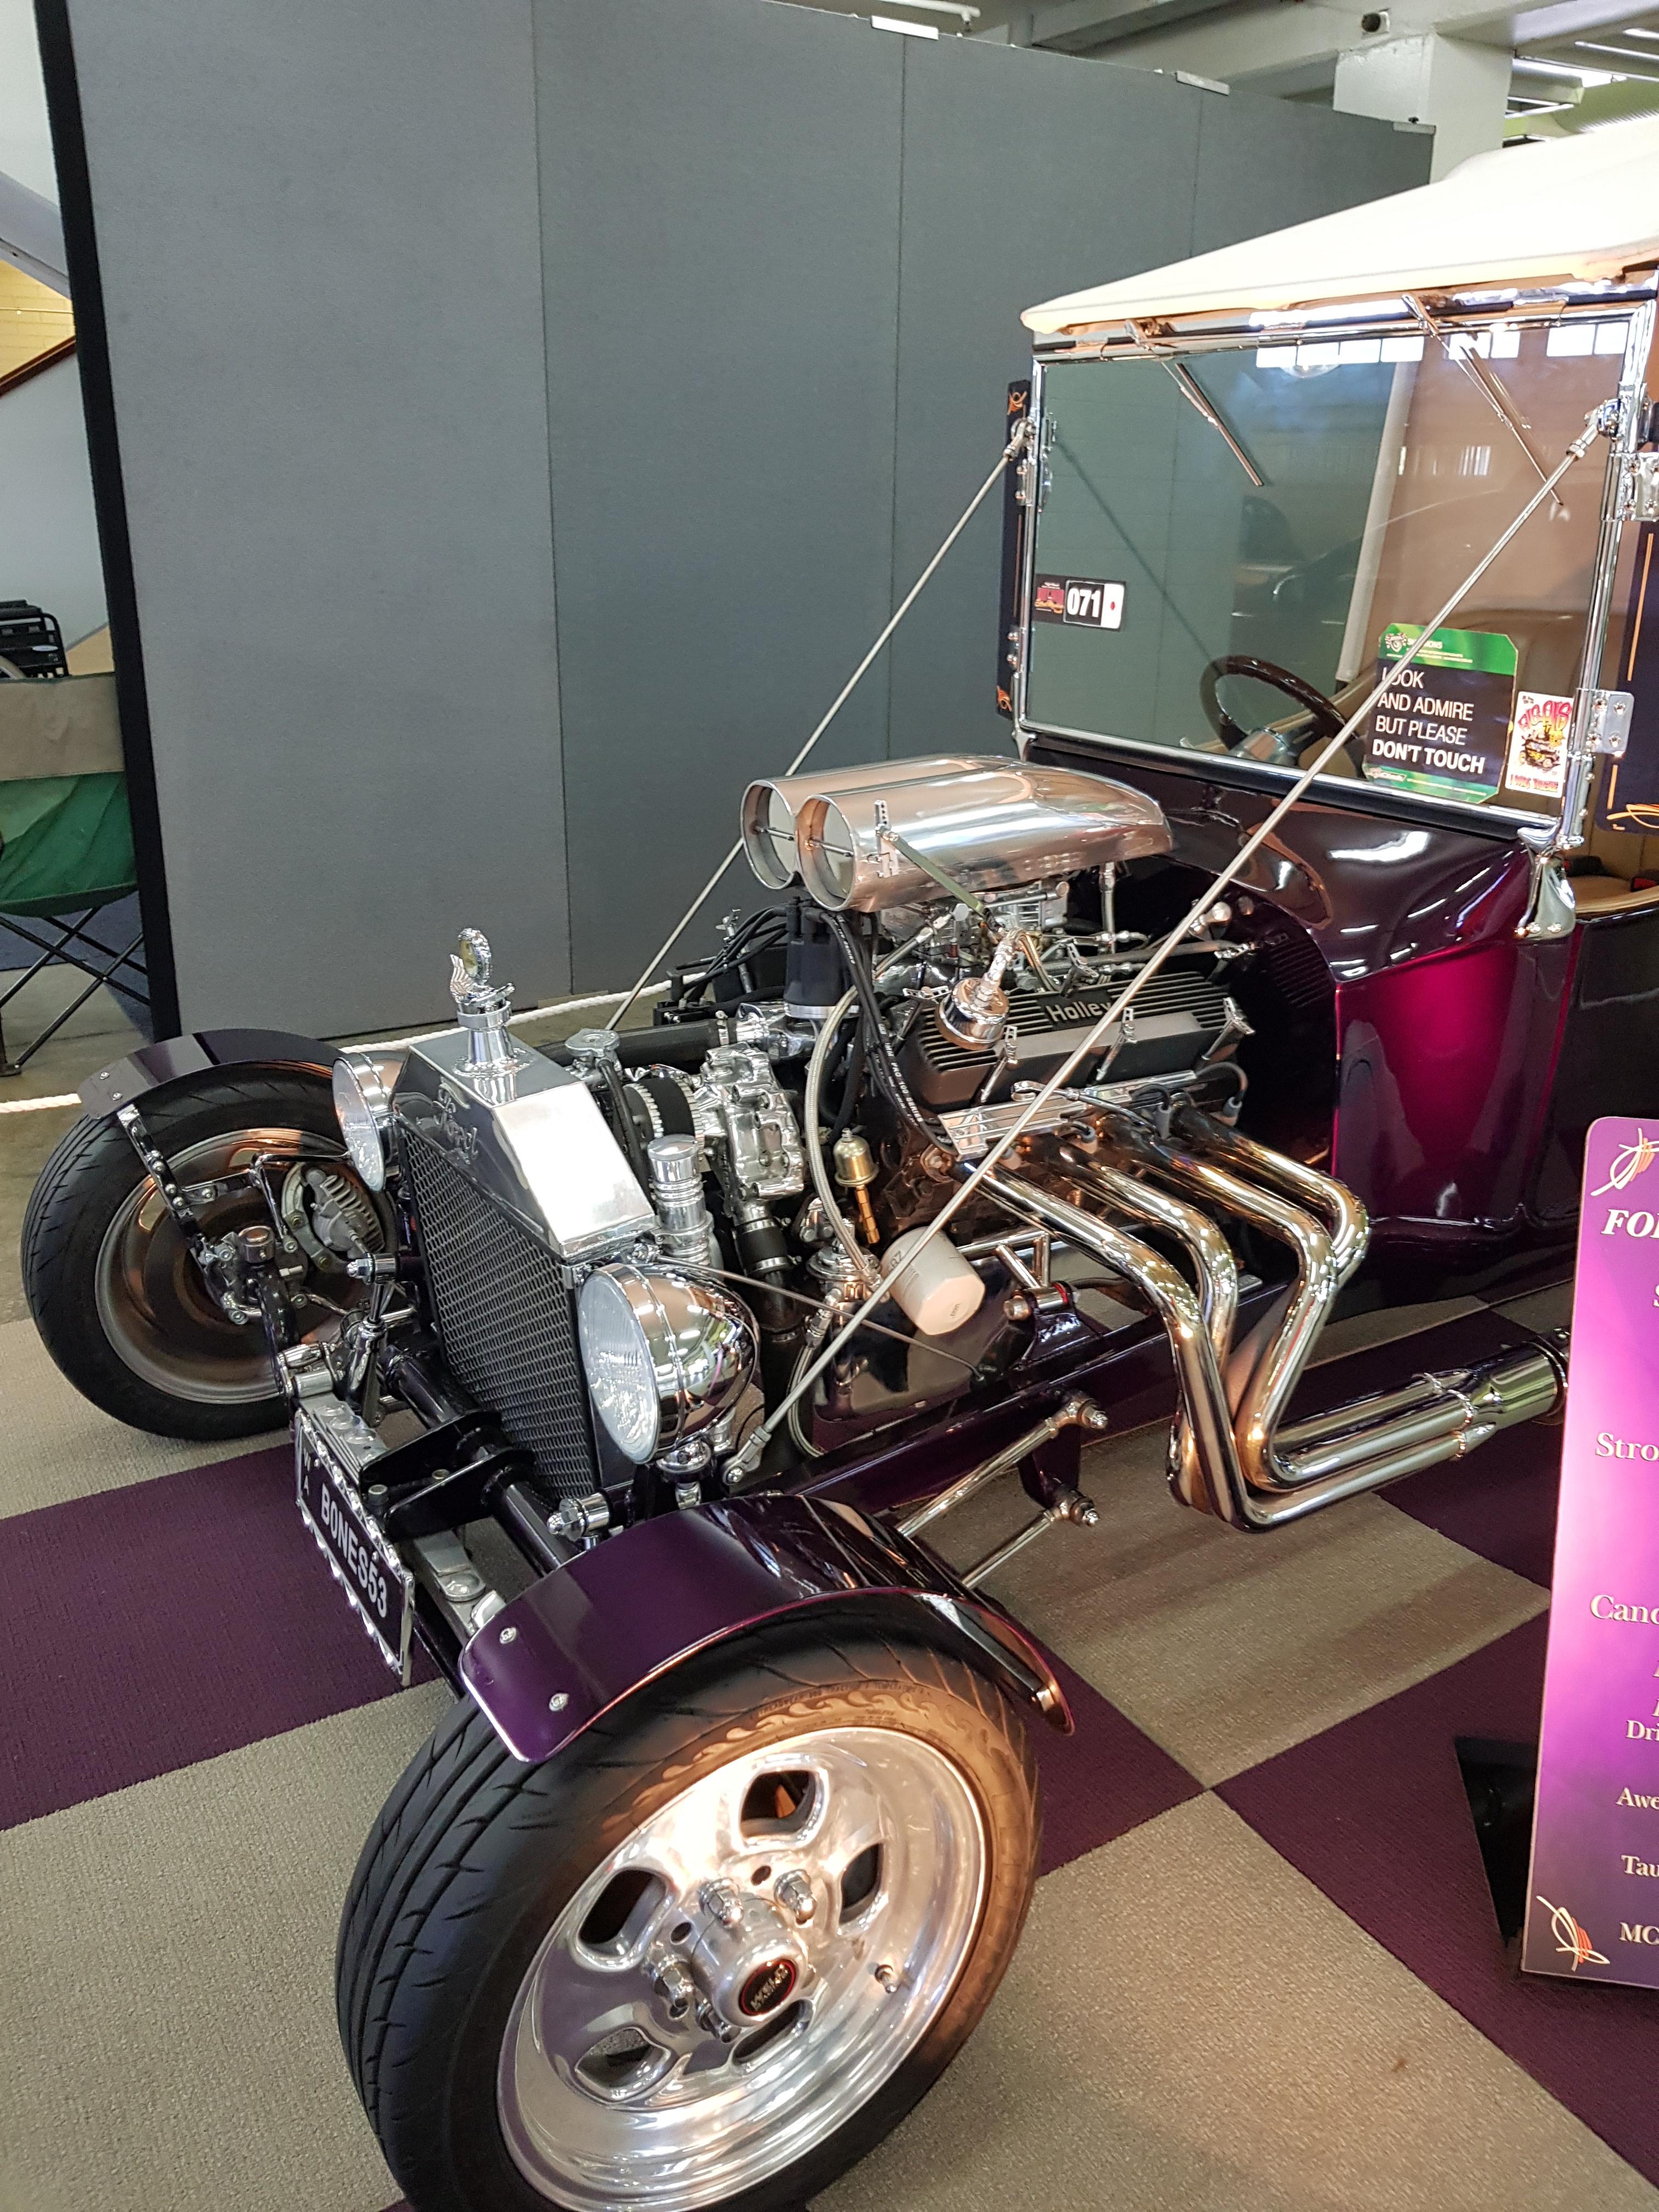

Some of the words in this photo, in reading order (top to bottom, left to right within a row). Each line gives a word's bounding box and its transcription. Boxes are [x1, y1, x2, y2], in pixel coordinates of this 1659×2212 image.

[1066, 588, 1101, 618] 071
[1377, 692, 1411, 712] AND
[1413, 696, 1475, 721] ADMIRE
[1375, 715, 1407, 735] BUT
[1408, 720, 1468, 746] PLEASE
[1372, 738, 1422, 763] DON'T
[1424, 747, 1486, 774] TOUCH
[1045, 1001, 1111, 1022] Holley
[320, 1483, 387, 1618] BONES53
